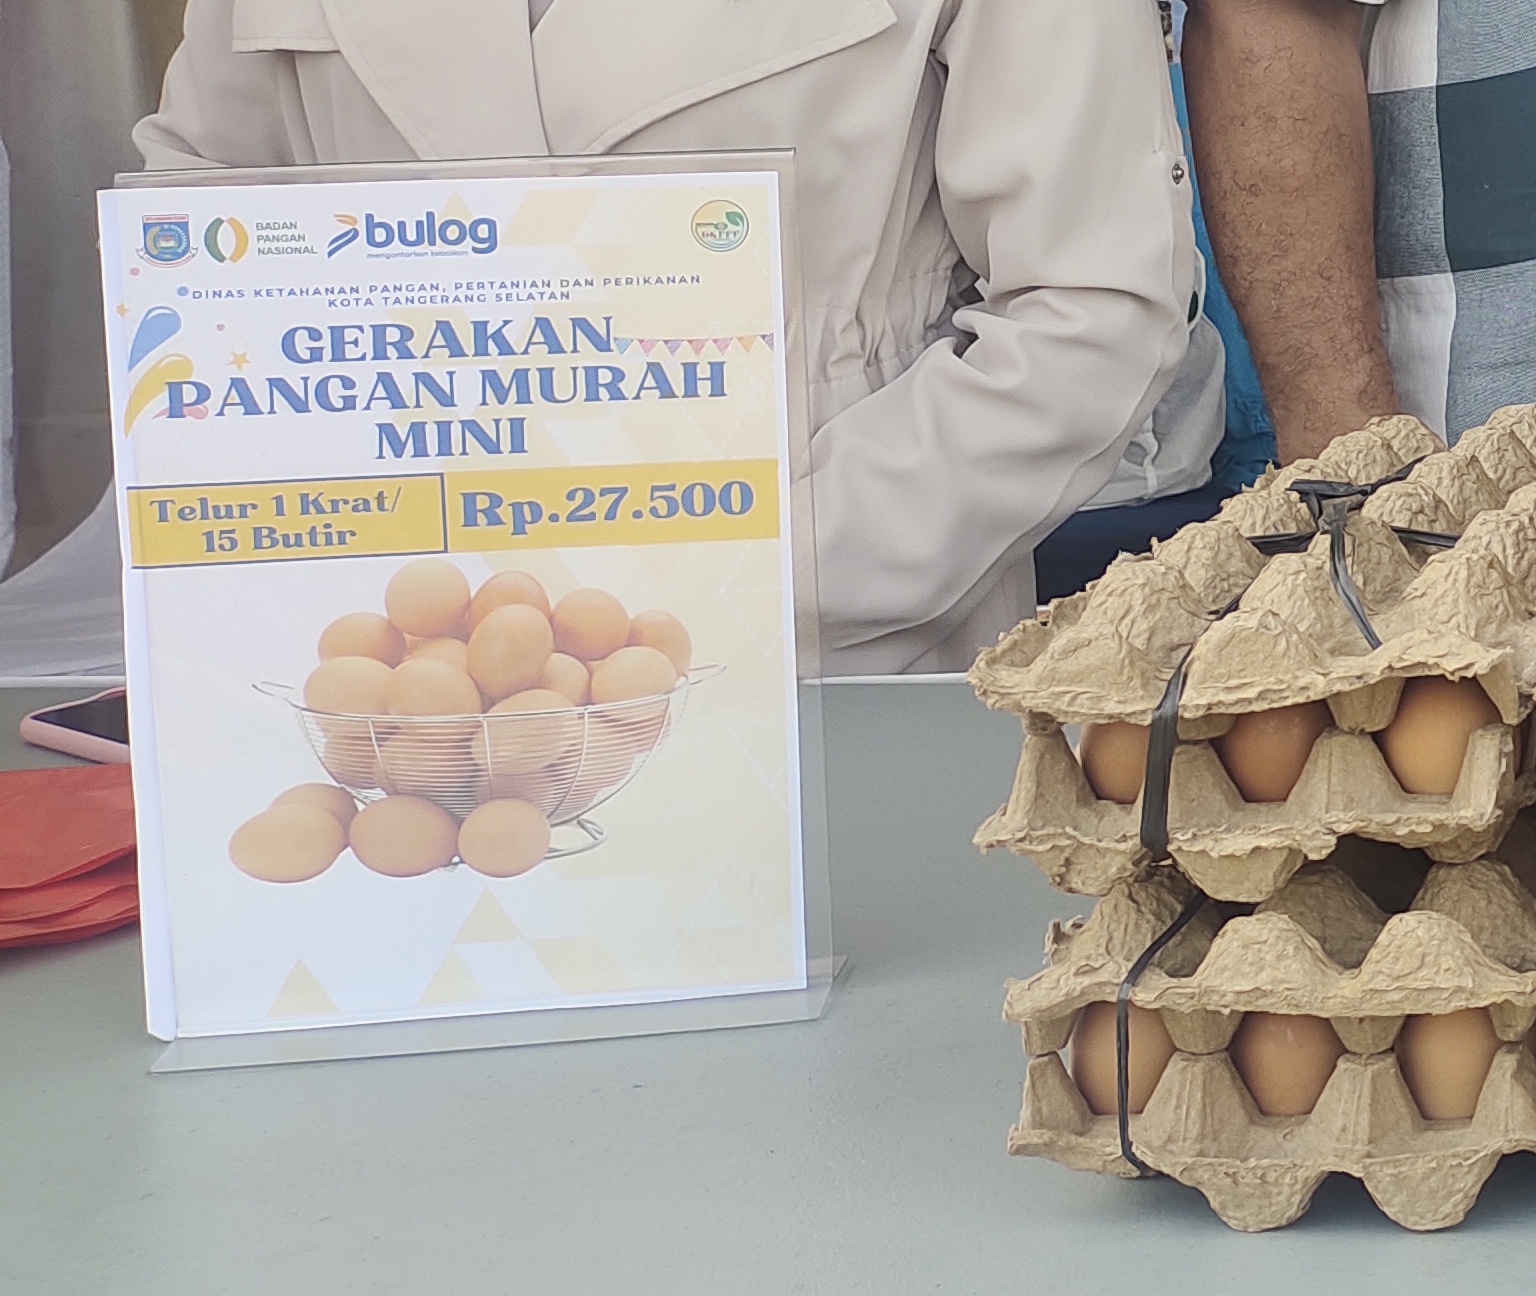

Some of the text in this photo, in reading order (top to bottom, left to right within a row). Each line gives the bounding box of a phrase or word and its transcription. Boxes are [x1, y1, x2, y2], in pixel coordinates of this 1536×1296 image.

[255, 221, 298, 231] BADAN
[256, 232, 307, 244] PANGAN
[364, 210, 499, 255] bulog
[257, 245, 319, 256] NASIONAL
[192, 274, 702, 300] DINAS KETAHANAN PANGAN, PERTANIAN DAN PERIKANAN
[327, 290, 572, 309] KOTA TANGERANG SELATAN
[280, 314, 615, 366] GERAKAN
[164, 360, 728, 420] PANGAN MURAH
[374, 415, 529, 461] MINI
[149, 485, 403, 524] Telur 1 Krat/
[458, 480, 755, 537] Rp.27.500
[201, 522, 359, 554] 15 Butir
